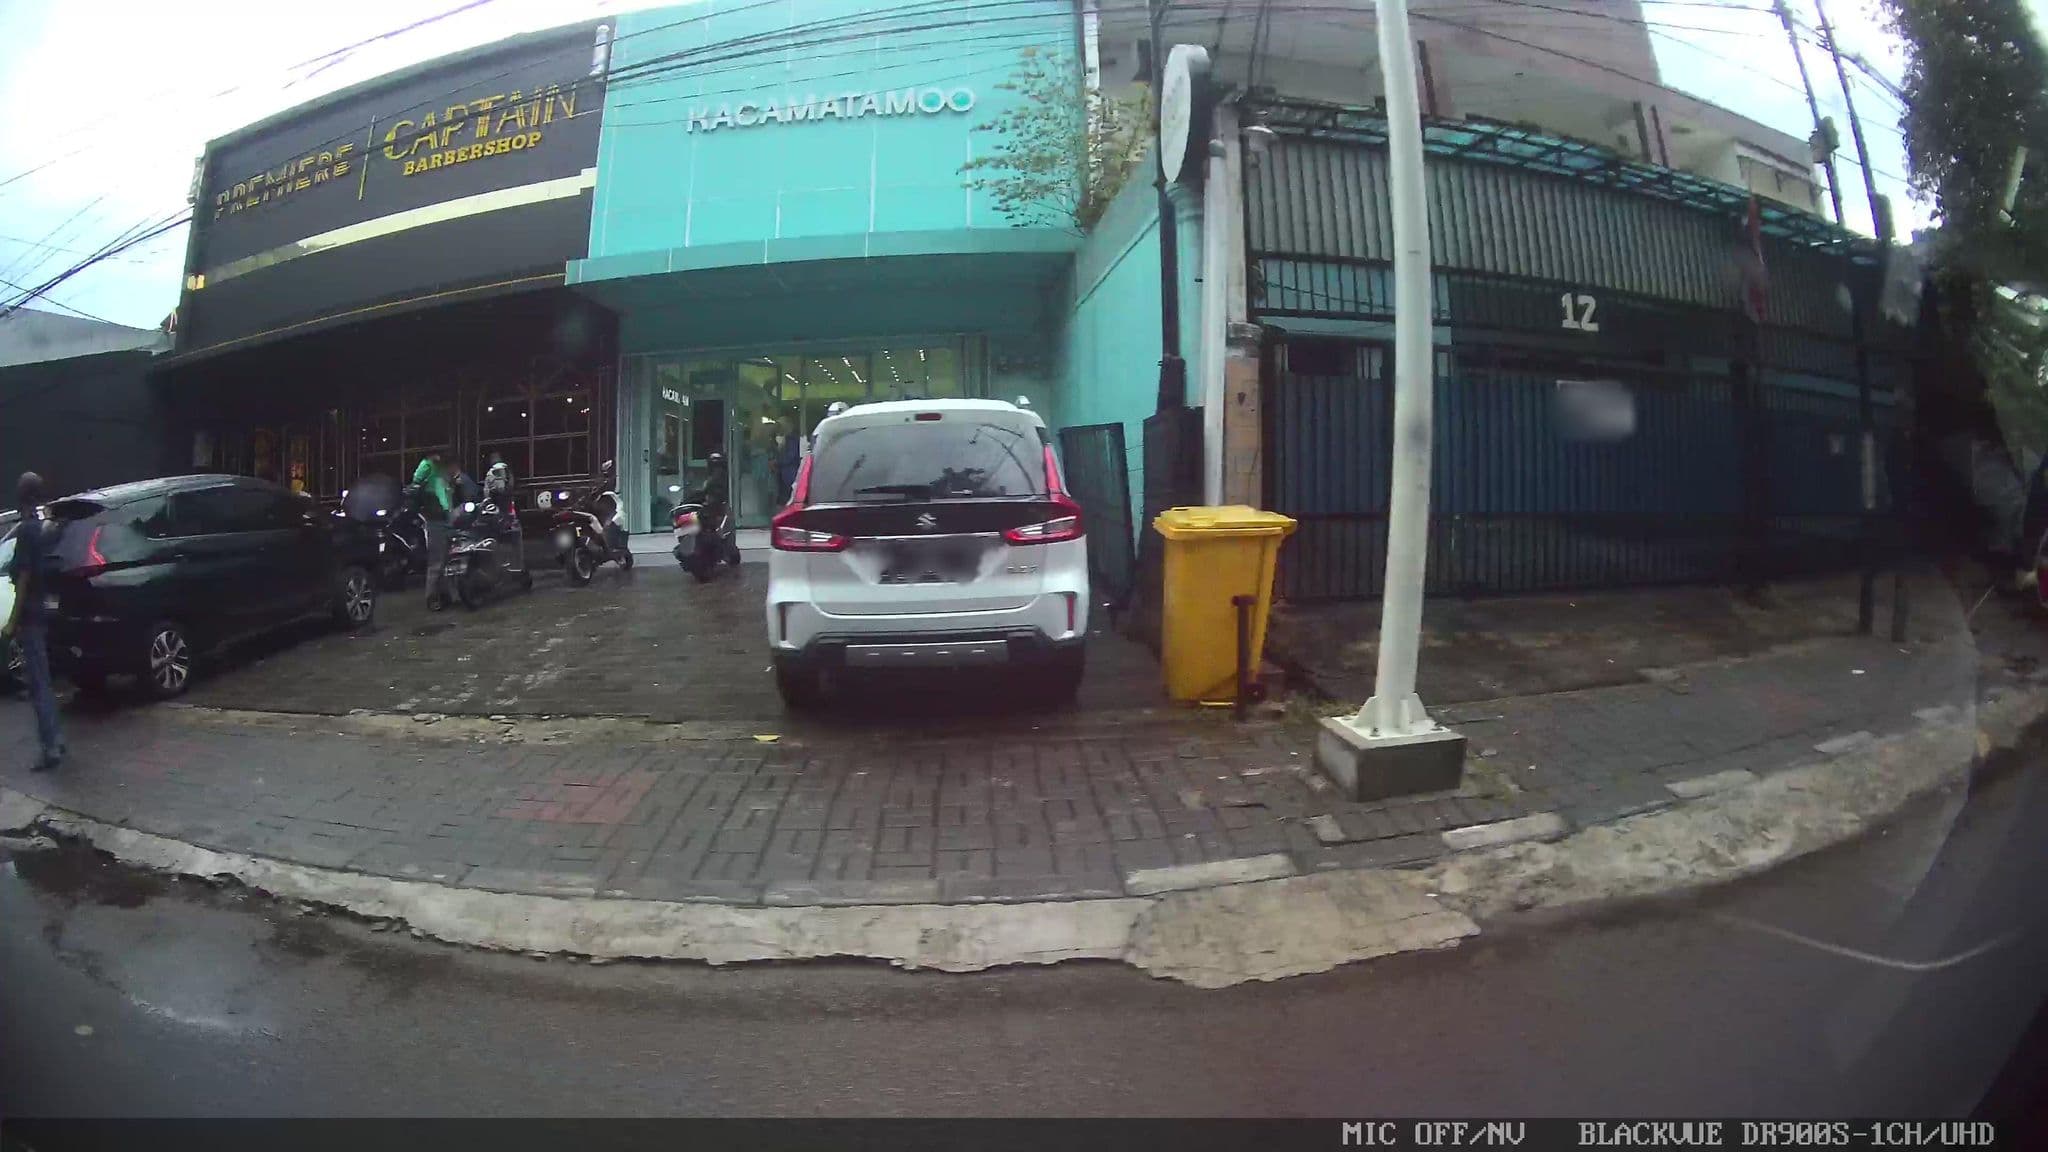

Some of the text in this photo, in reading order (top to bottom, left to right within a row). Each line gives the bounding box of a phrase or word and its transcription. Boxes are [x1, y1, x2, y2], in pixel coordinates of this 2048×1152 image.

[384, 79, 578, 160] CAPTAIN
[687, 86, 976, 132] KACAMATAMOO
[402, 130, 543, 176] BARBERSHOP
[214, 142, 352, 221] PREMIERE
[1561, 292, 1600, 332] 12
